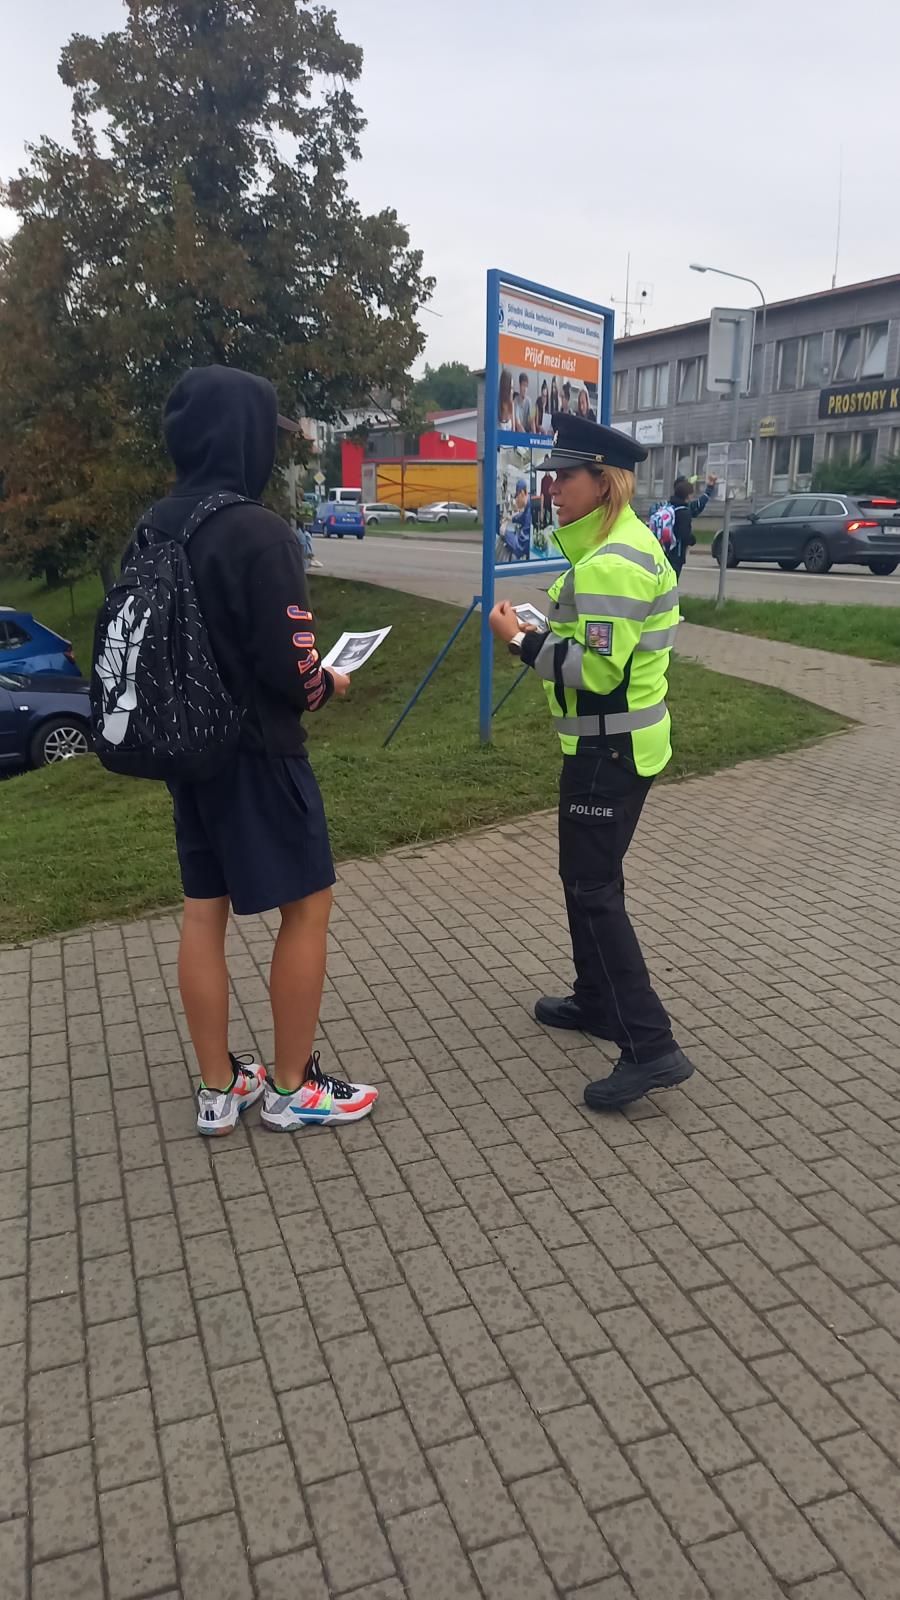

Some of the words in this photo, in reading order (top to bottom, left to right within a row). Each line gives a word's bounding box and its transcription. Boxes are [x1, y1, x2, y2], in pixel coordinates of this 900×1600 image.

[524, 346, 545, 368] Přijď
[543, 354, 561, 369] mezi
[561, 358, 576, 371] nás!
[828, 389, 887, 415] PROSTORY
[569, 804, 614, 817] POLICIE
